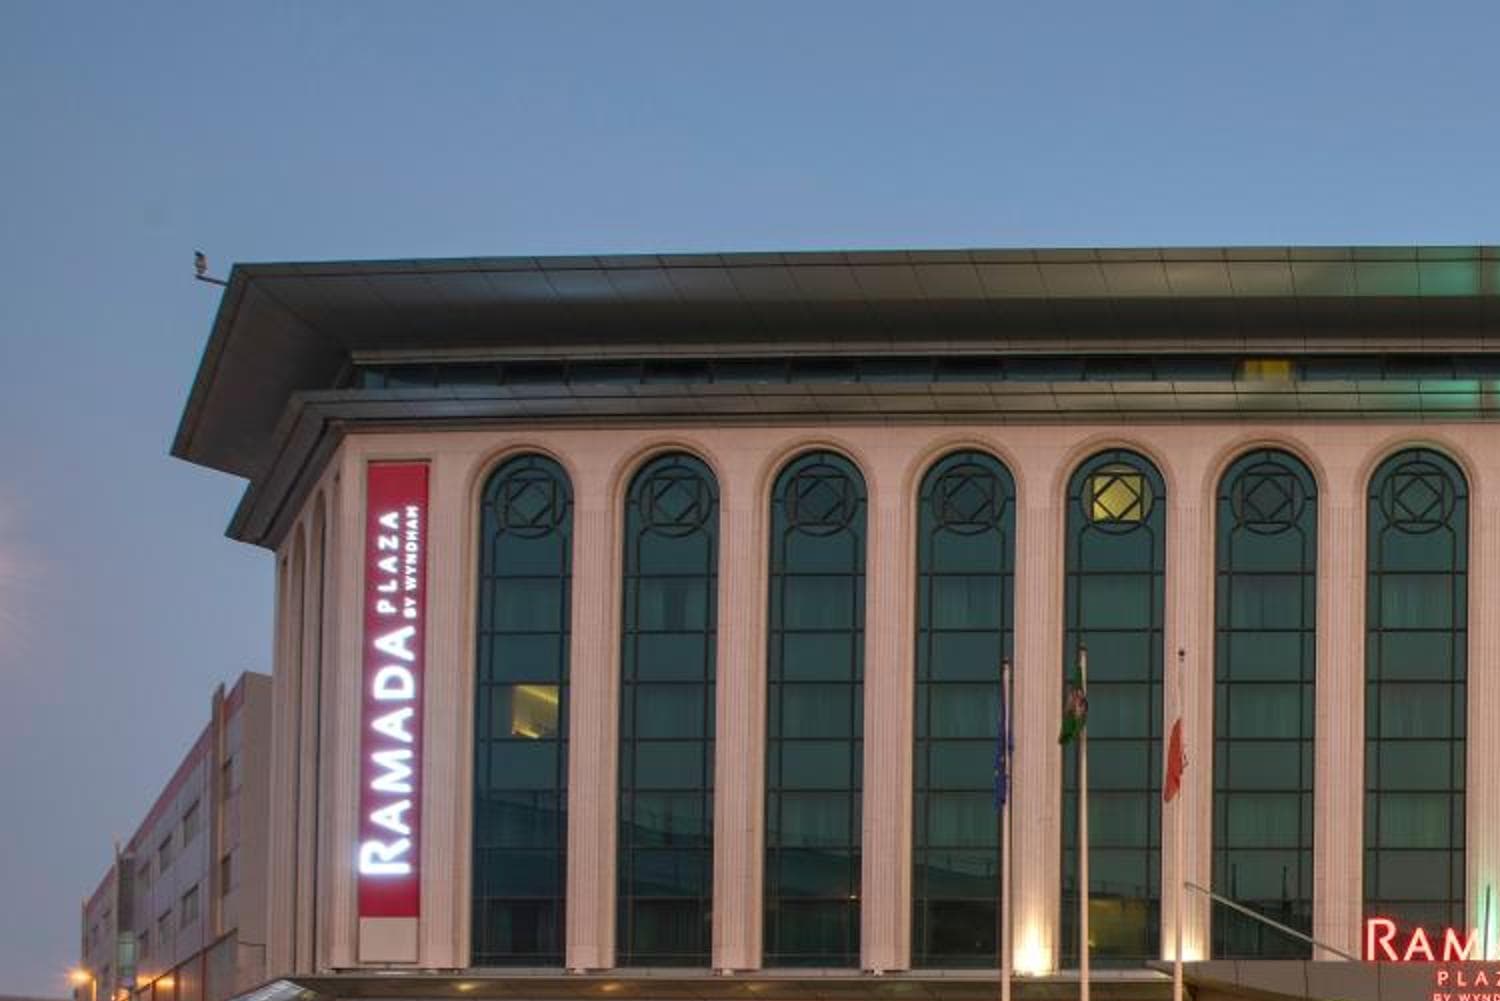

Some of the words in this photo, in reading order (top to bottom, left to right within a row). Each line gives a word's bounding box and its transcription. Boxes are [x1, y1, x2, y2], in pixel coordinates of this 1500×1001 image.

[376, 511, 398, 614] PLAZA
[405, 506, 419, 592] WYNDHAM
[403, 598, 416, 618] BY
[359, 626, 416, 875] RAMADA
